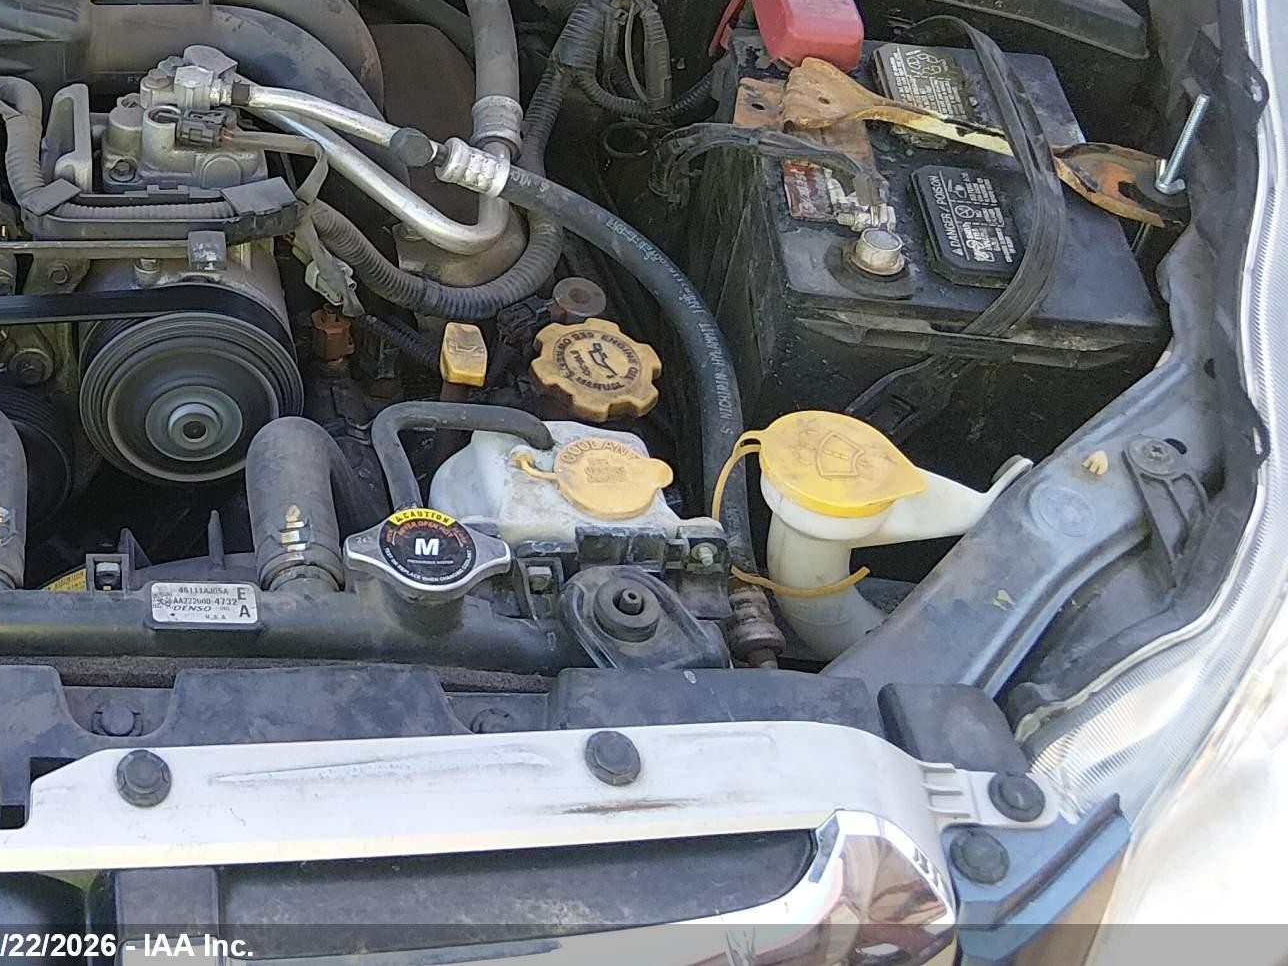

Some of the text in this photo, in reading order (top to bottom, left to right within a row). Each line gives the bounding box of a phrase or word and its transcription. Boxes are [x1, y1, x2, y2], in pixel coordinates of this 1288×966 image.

[928, 175, 948, 206] POISON
[941, 212, 964, 249] DANGER
[600, 333, 637, 365] ENGINE
[561, 440, 643, 464] COOLANT
[402, 510, 451, 523] CAUTION
[417, 521, 439, 530] OPEN
[414, 538, 440, 556] M
[397, 564, 422, 580] REPLACE
[236, 587, 247, 601] E
[239, 605, 251, 618] A
